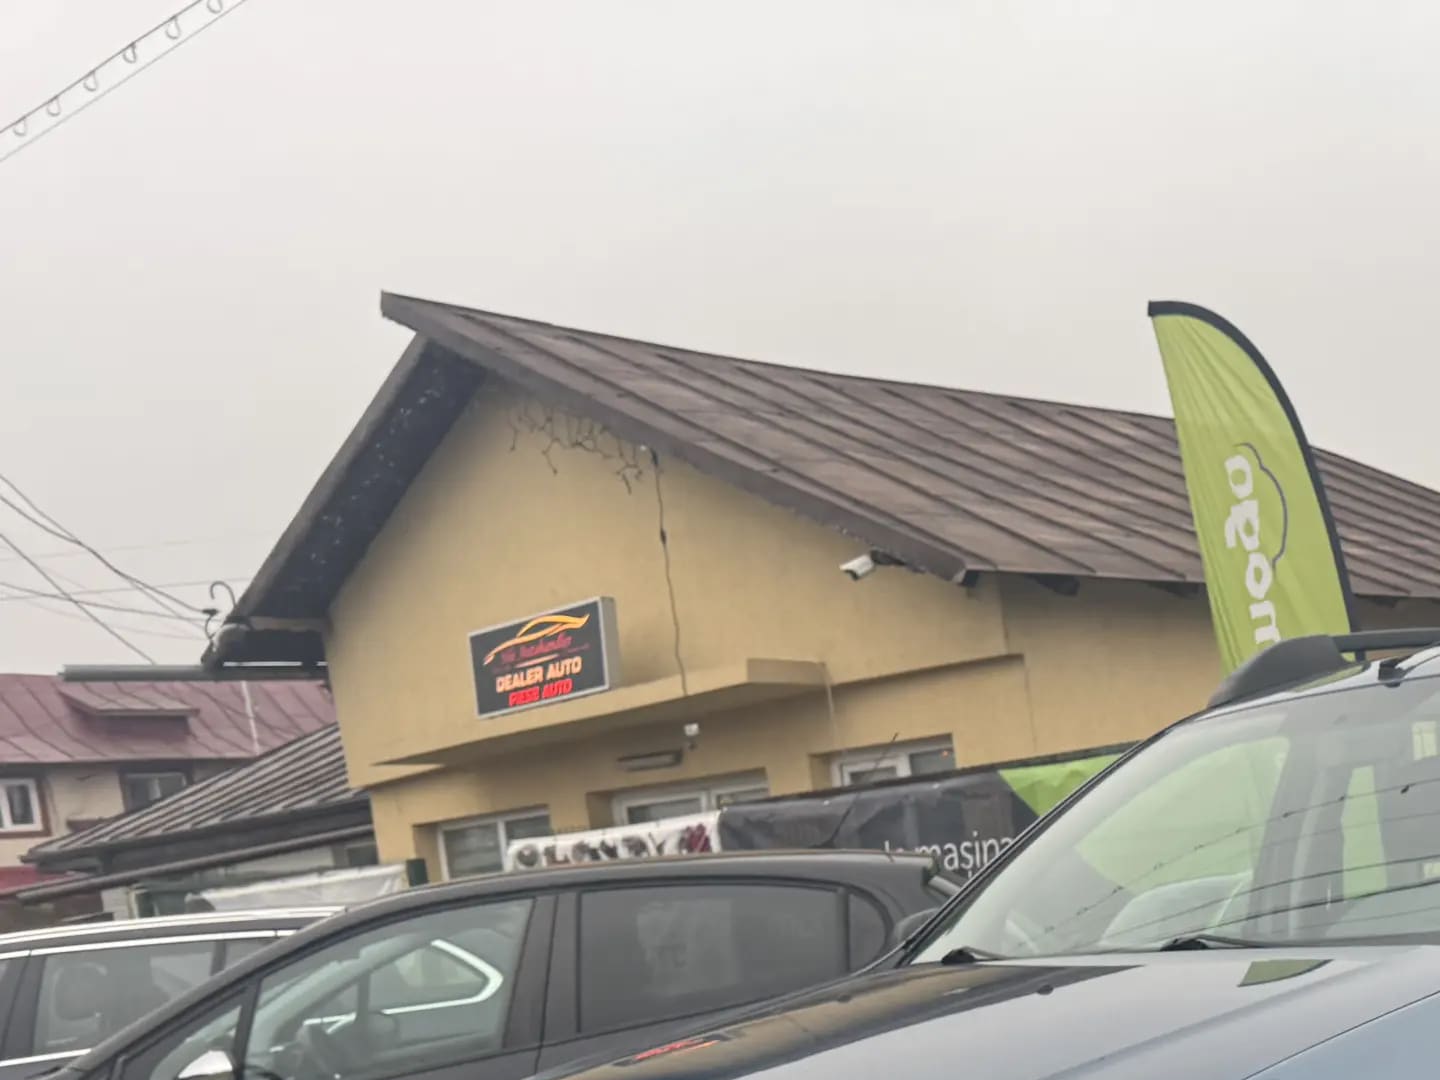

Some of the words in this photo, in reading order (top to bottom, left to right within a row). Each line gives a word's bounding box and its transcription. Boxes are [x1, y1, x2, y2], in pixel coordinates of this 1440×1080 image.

[496, 666, 544, 693] DEALER
[546, 656, 582, 680] AUTO
[541, 678, 573, 699] AUTO
